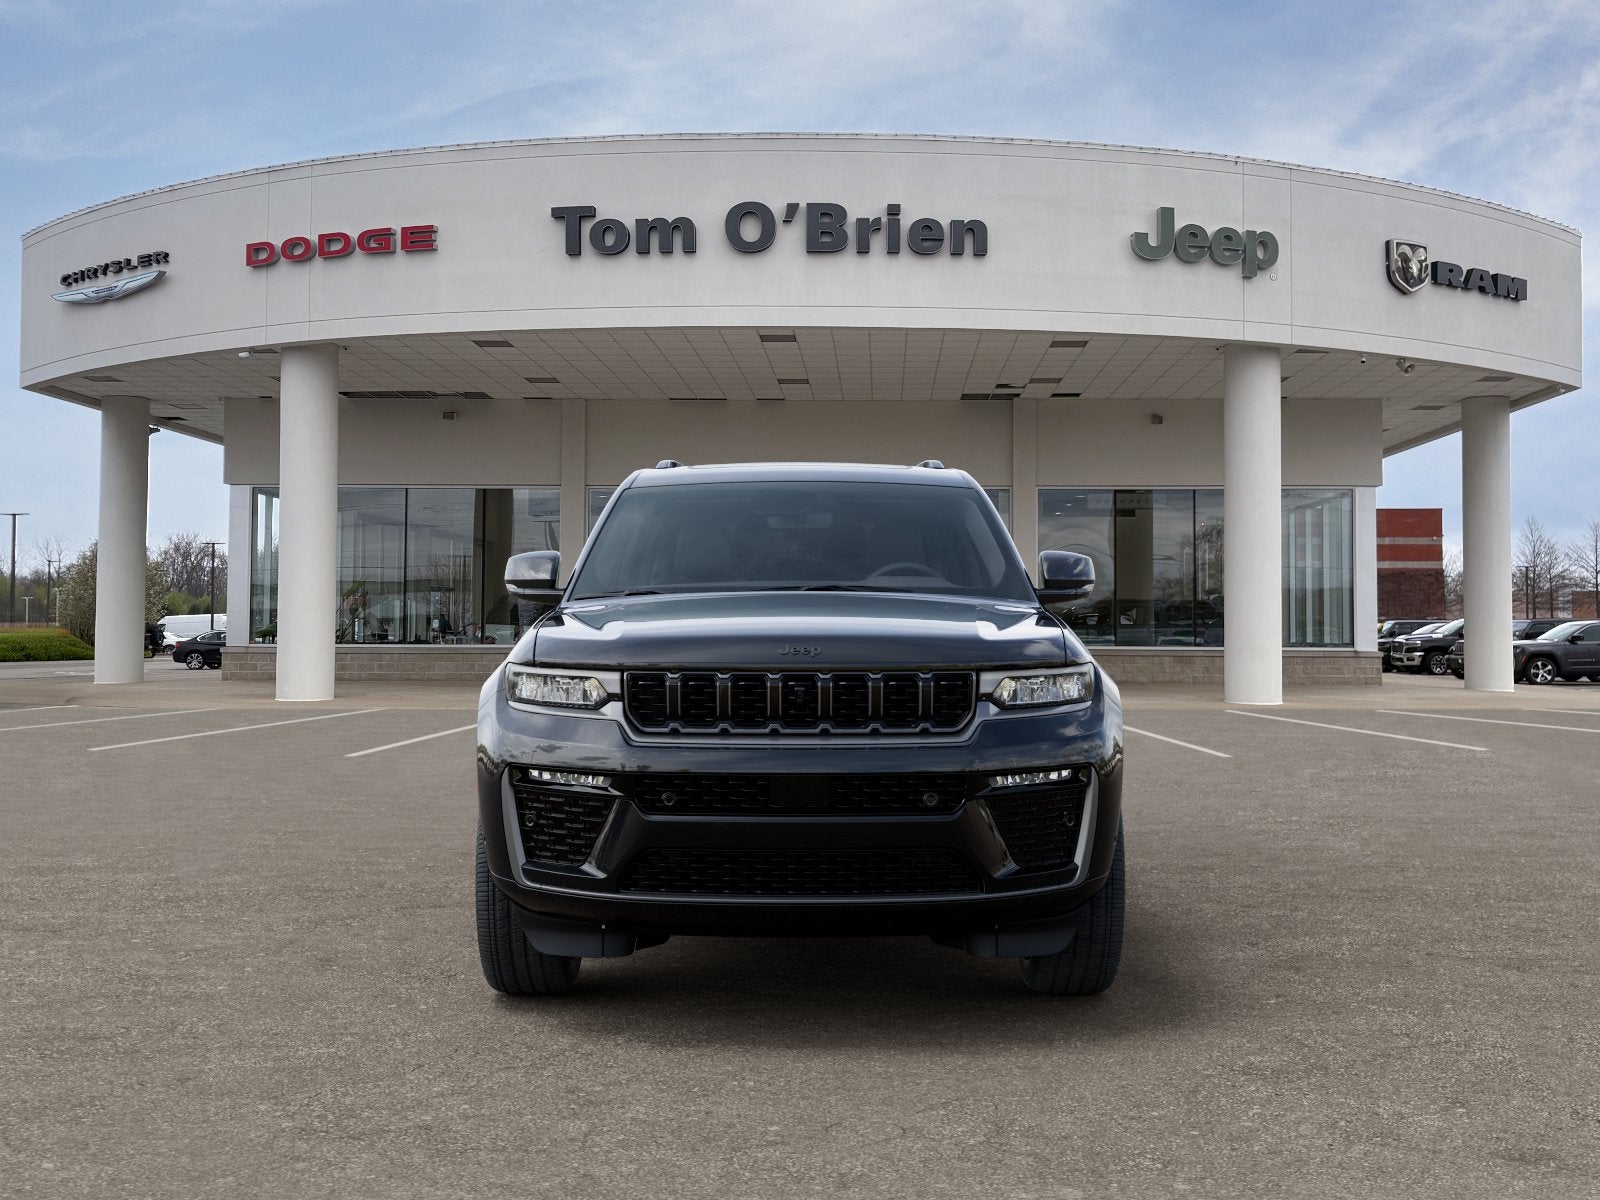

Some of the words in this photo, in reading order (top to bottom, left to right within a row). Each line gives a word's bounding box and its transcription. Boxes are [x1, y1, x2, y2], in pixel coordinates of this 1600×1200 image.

[245, 224, 438, 268] DODGE
[551, 205, 697, 256] Tom
[724, 201, 989, 256] O'Brien
[1130, 206, 1279, 278] Jeep
[60, 250, 170, 287] CHRYSLER
[1431, 260, 1528, 301] RAM
[779, 643, 822, 657] Jeep
